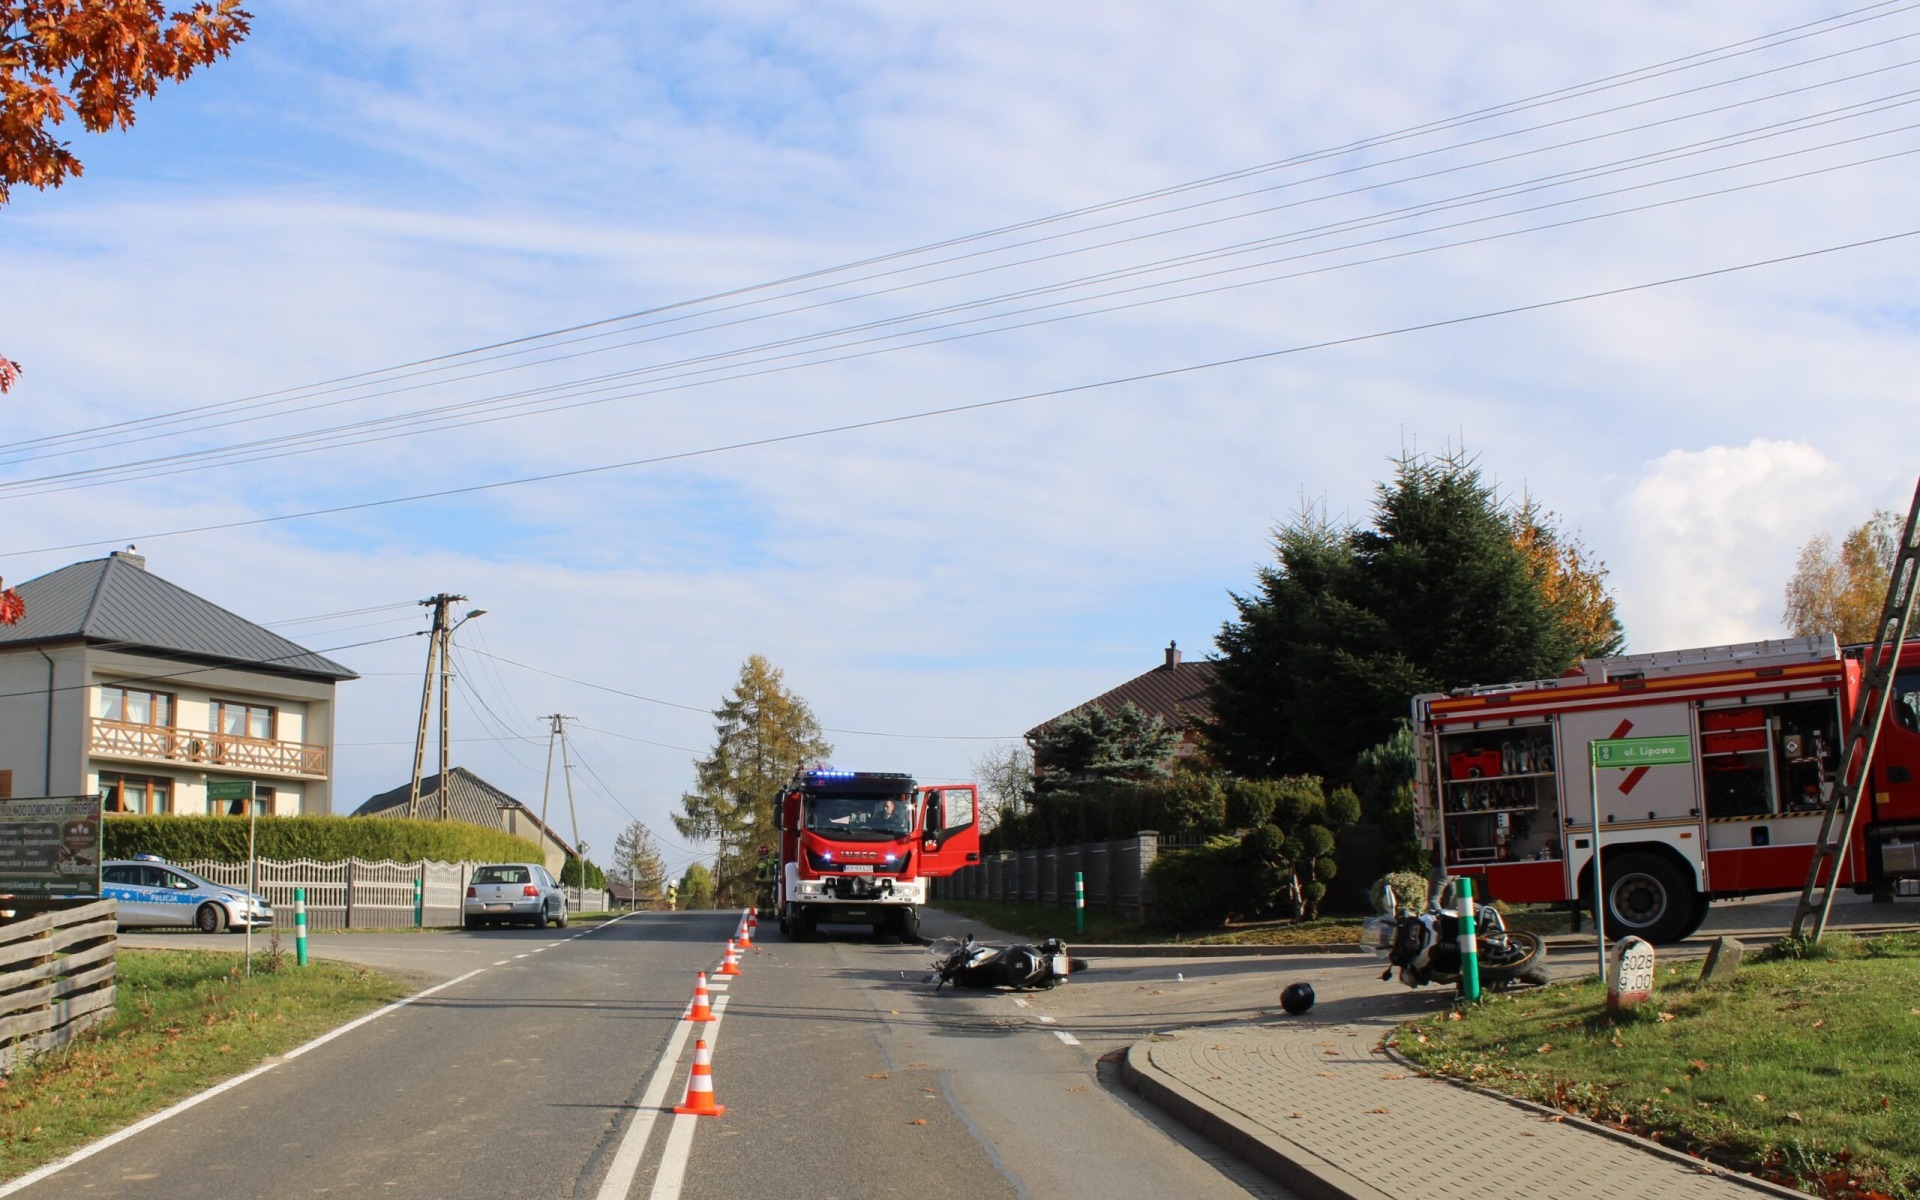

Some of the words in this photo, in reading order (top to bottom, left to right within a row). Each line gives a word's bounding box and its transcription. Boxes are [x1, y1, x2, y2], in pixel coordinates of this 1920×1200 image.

[1624, 748, 1636, 756] ul.
[1640, 746, 1675, 757] Lipowa
[840, 851, 877, 859] IVECO
[150, 894, 178, 902] POLICJA
[1622, 954, 1653, 971] G028
[1619, 974, 1650, 991] 9.00
